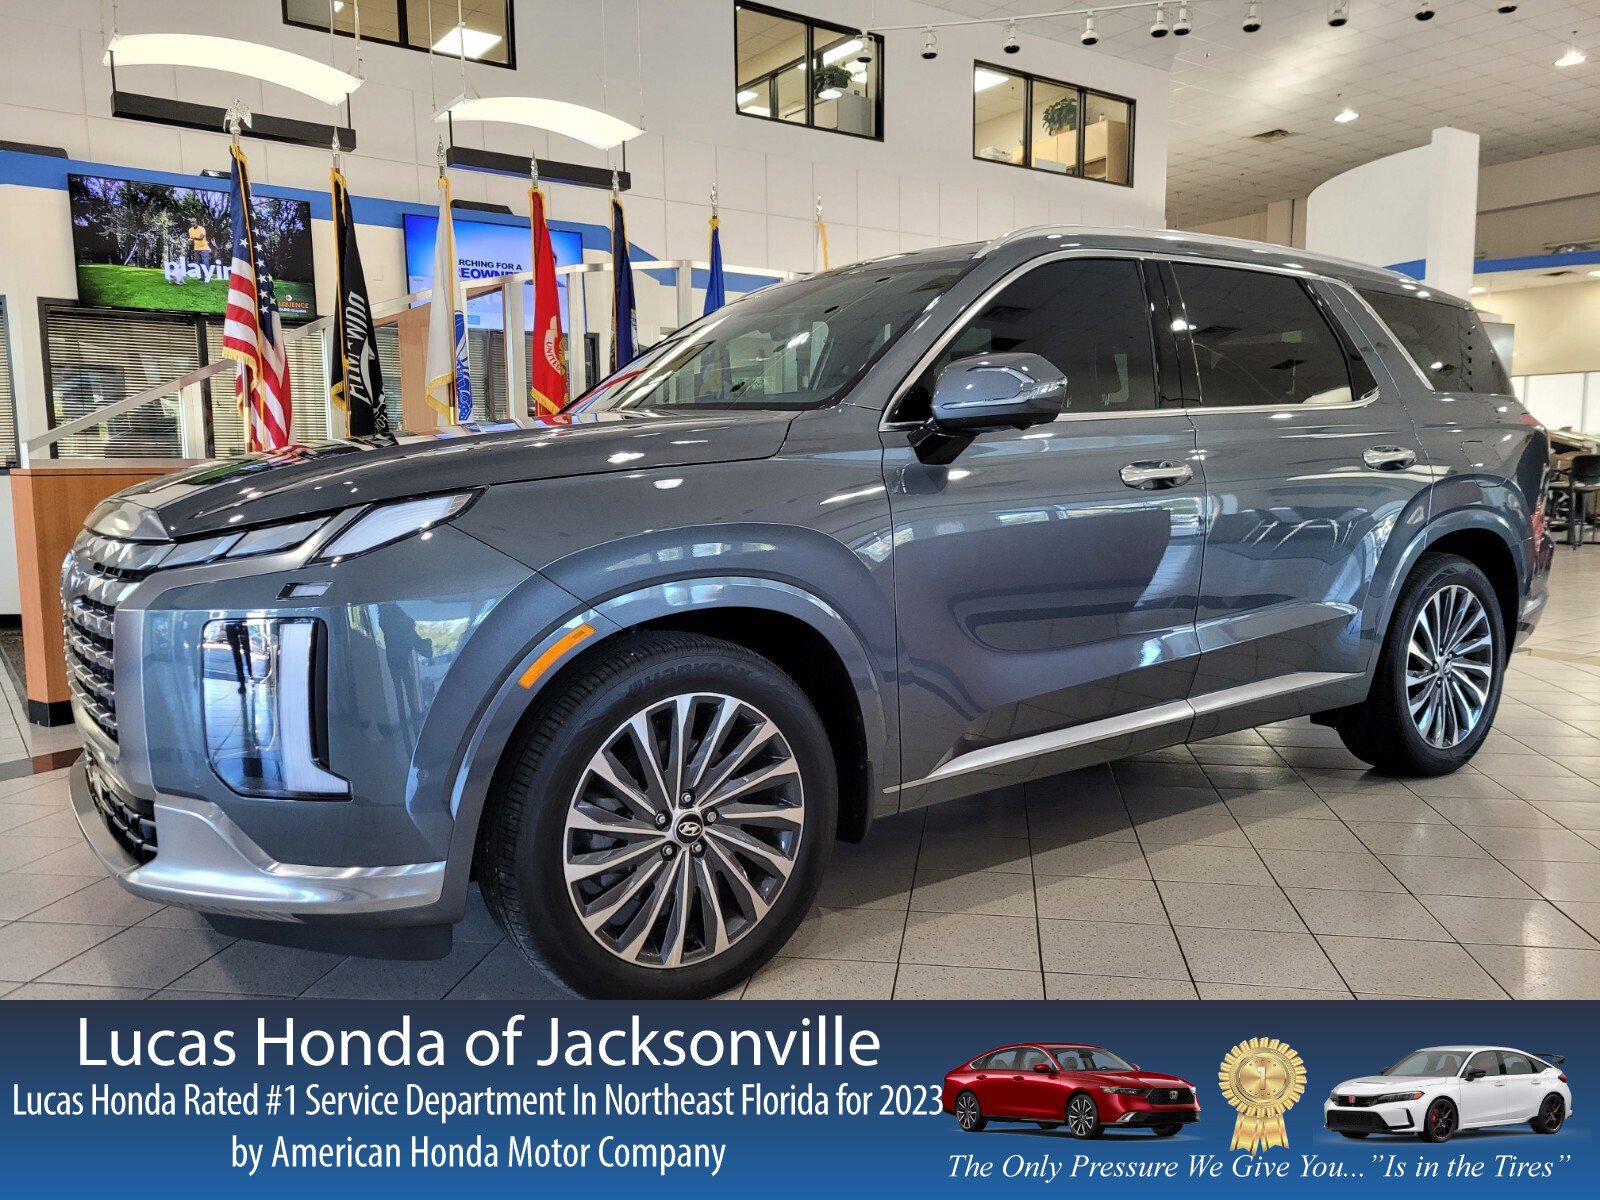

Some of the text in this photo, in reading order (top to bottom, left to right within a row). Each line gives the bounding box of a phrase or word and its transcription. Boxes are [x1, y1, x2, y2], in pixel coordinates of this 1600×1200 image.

[164, 256, 232, 283] playin
[458, 259, 494, 269] RCHING
[496, 262, 514, 270] FOR
[546, 341, 561, 370] UNITED
